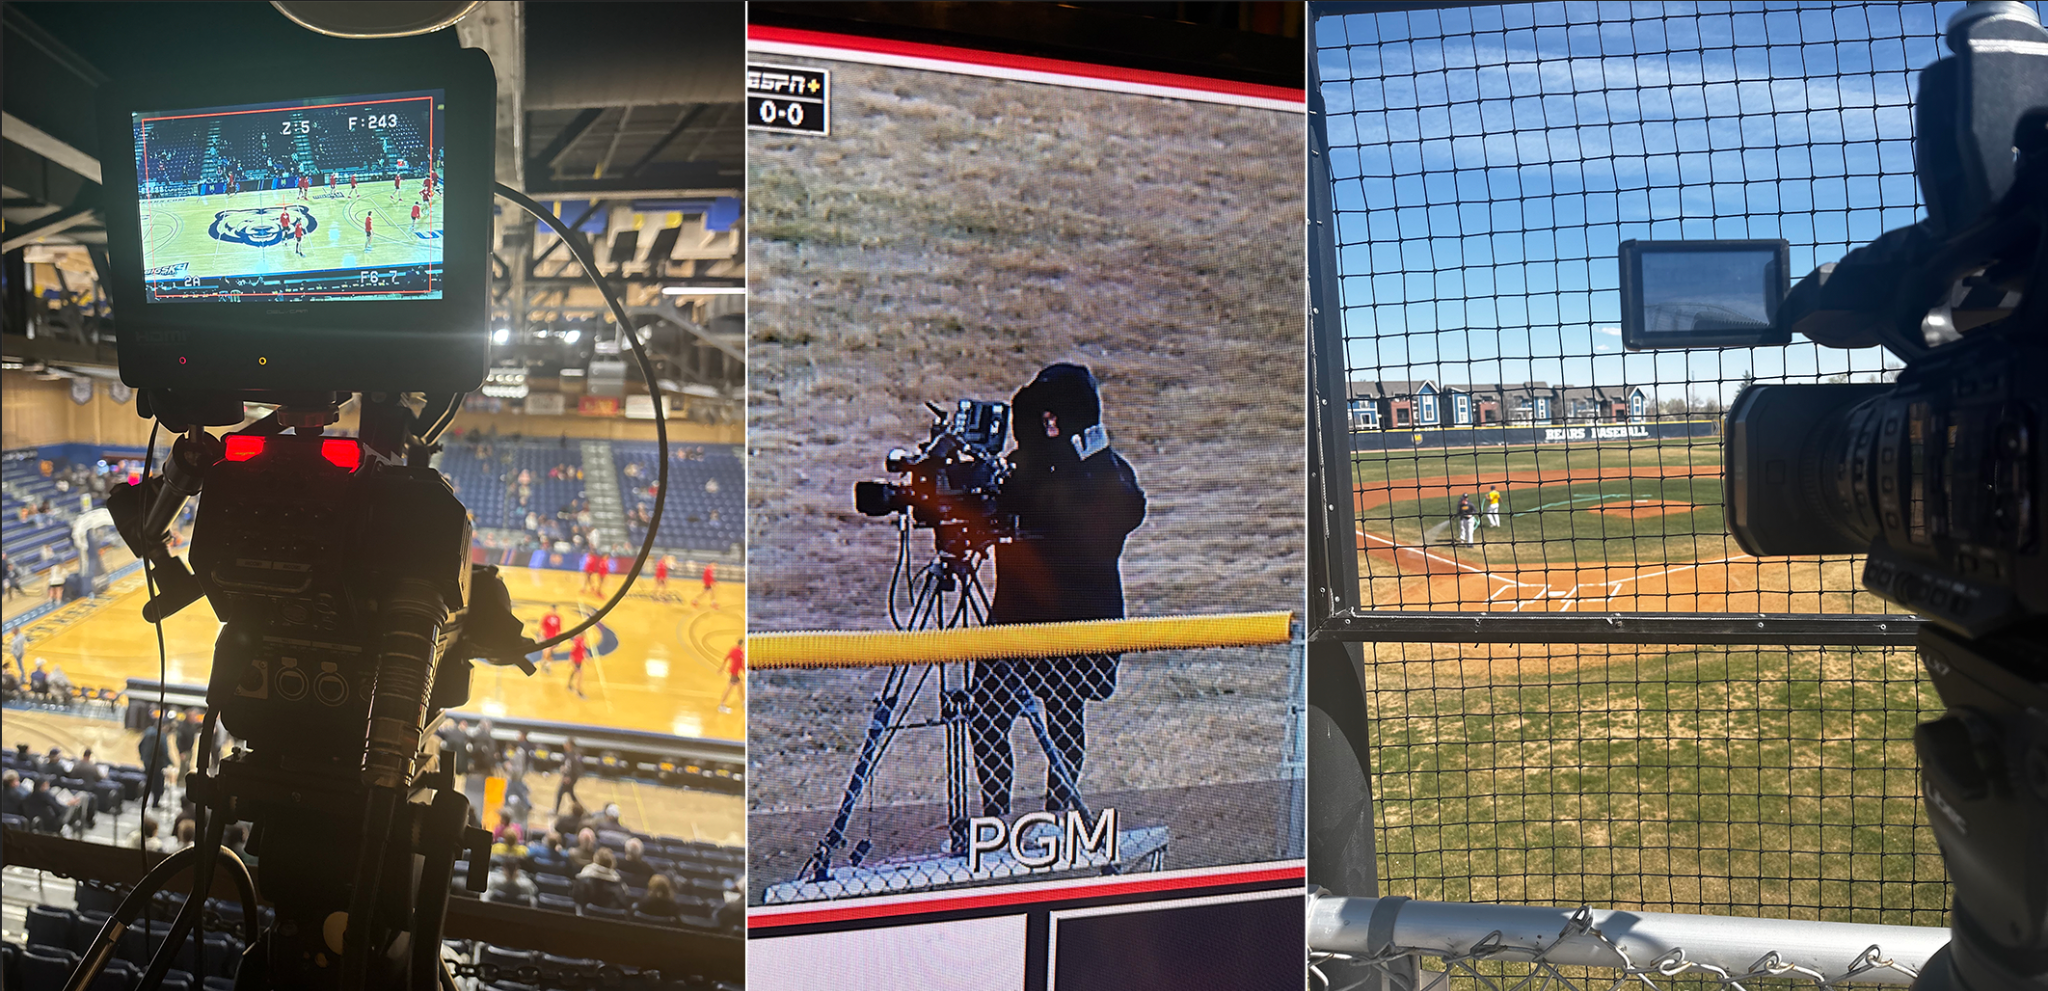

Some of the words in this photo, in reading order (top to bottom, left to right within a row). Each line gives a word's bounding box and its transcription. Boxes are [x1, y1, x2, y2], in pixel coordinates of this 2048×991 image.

[748, 71, 820, 94] ESPN+
[759, 99, 804, 126] 0-0
[282, 120, 310, 135] Z:5
[348, 114, 398, 130] F:243
[184, 275, 201, 287] 2A
[1545, 428, 1586, 440] BEARS
[1591, 426, 1649, 438] BASEBALL
[968, 807, 1118, 873] PGM
